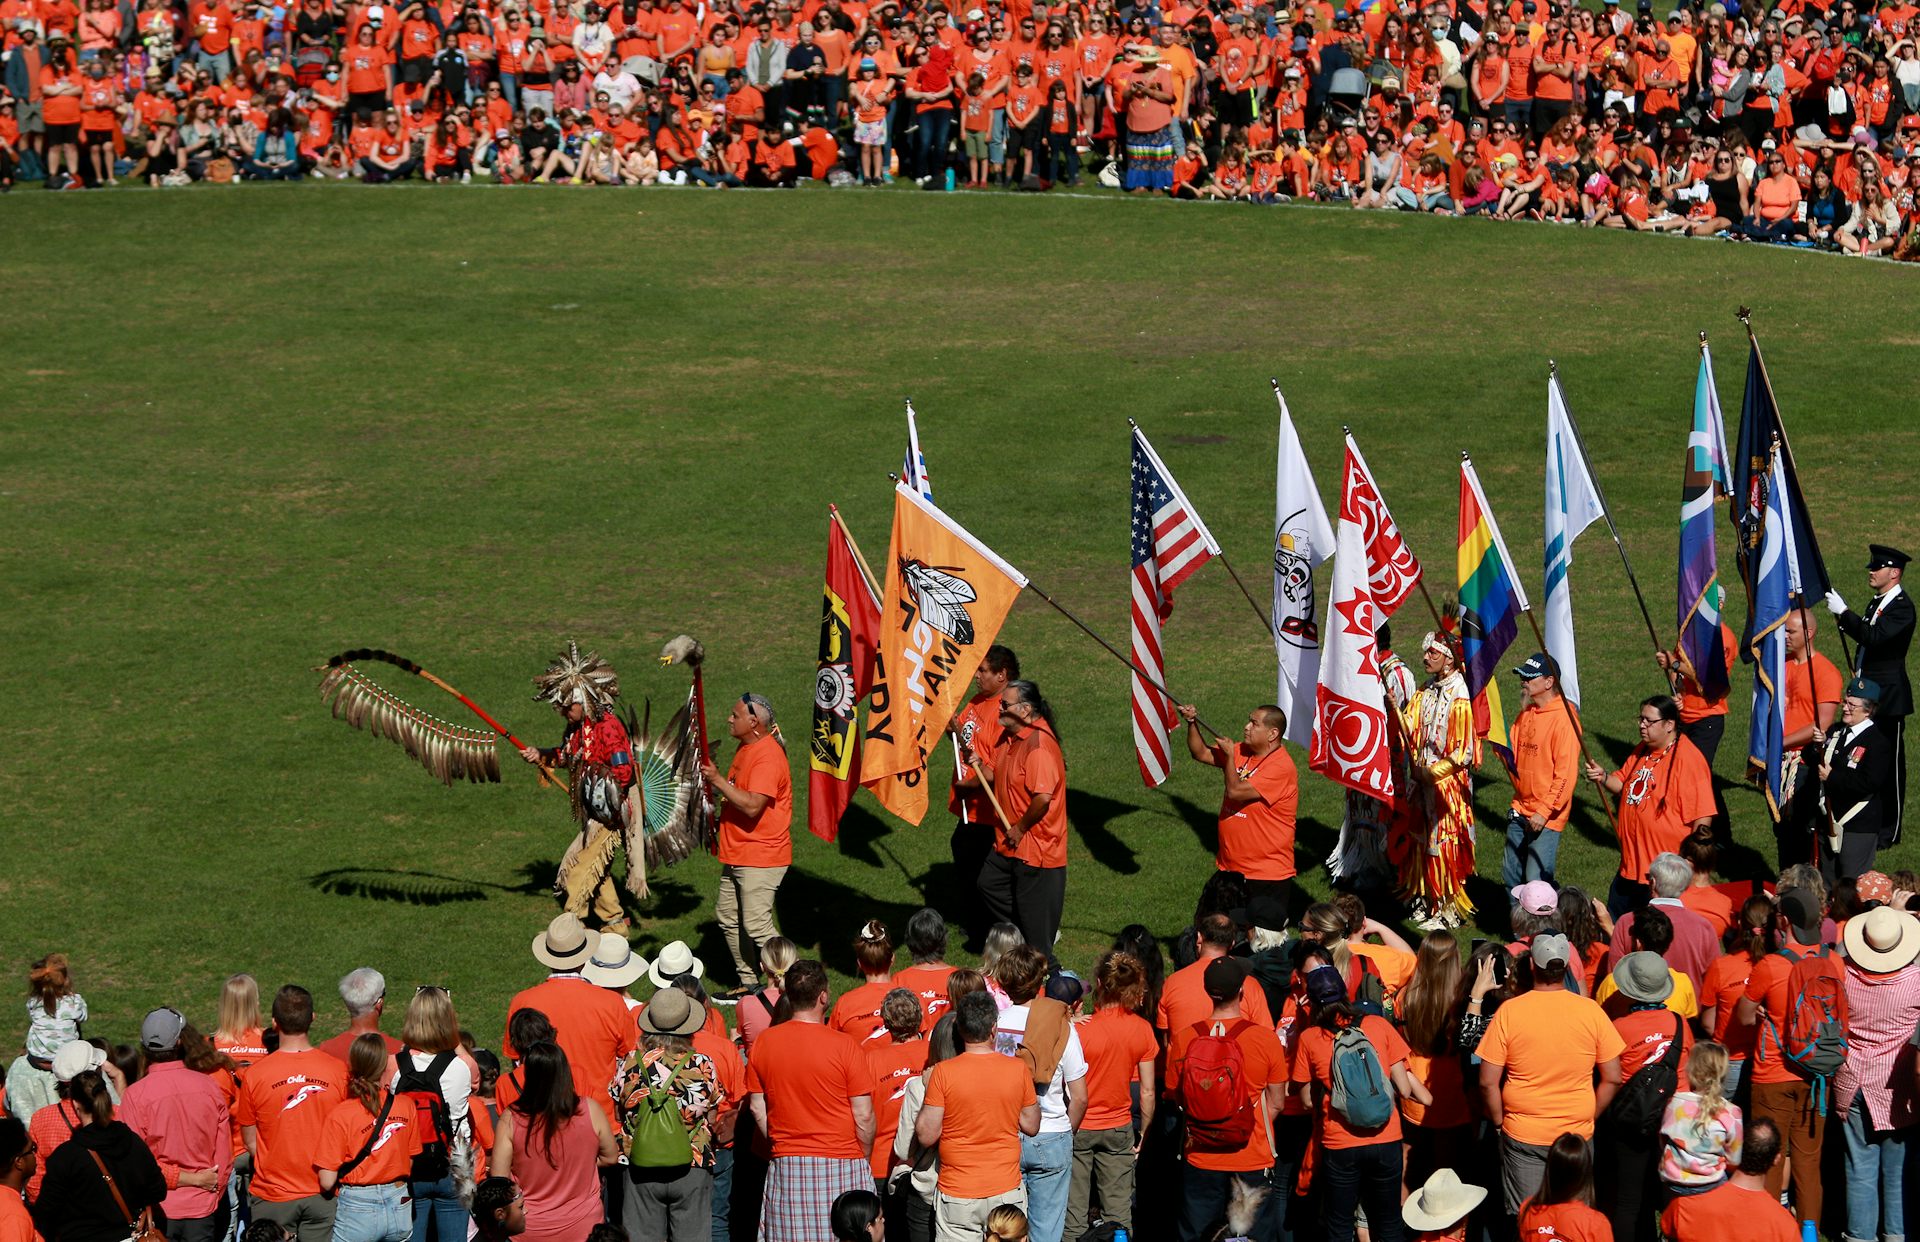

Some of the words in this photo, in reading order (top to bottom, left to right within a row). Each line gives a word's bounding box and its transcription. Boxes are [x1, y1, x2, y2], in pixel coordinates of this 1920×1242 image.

[1645, 1032, 1663, 1044] Child
[893, 1068, 910, 1077] Child
[271, 1079, 287, 1090] EVERY
[287, 1074, 306, 1084] Child
[305, 1077, 330, 1088] MATTERS
